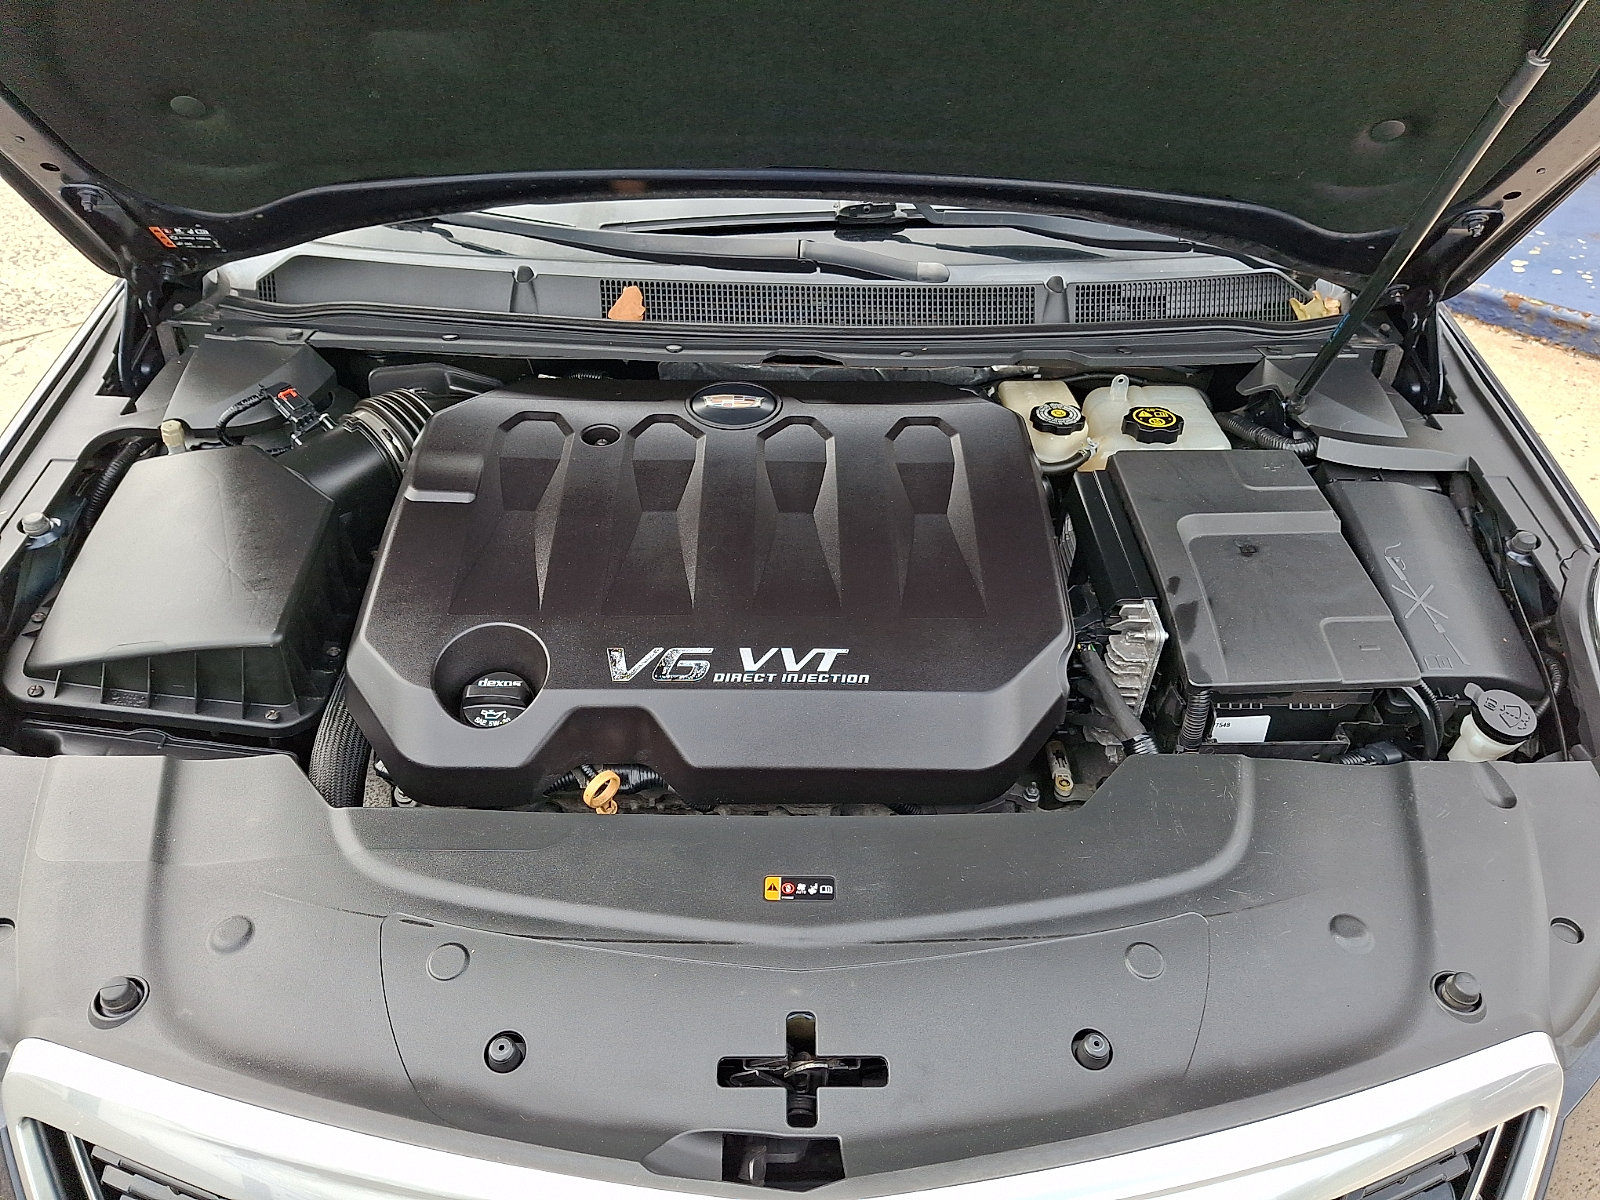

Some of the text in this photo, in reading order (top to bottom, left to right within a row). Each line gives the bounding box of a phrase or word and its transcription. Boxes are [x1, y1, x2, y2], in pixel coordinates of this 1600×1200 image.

[606, 647, 849, 683] V6 VVT
[477, 678, 523, 687] dexos
[712, 673, 870, 685] DIRECT INJECTION
